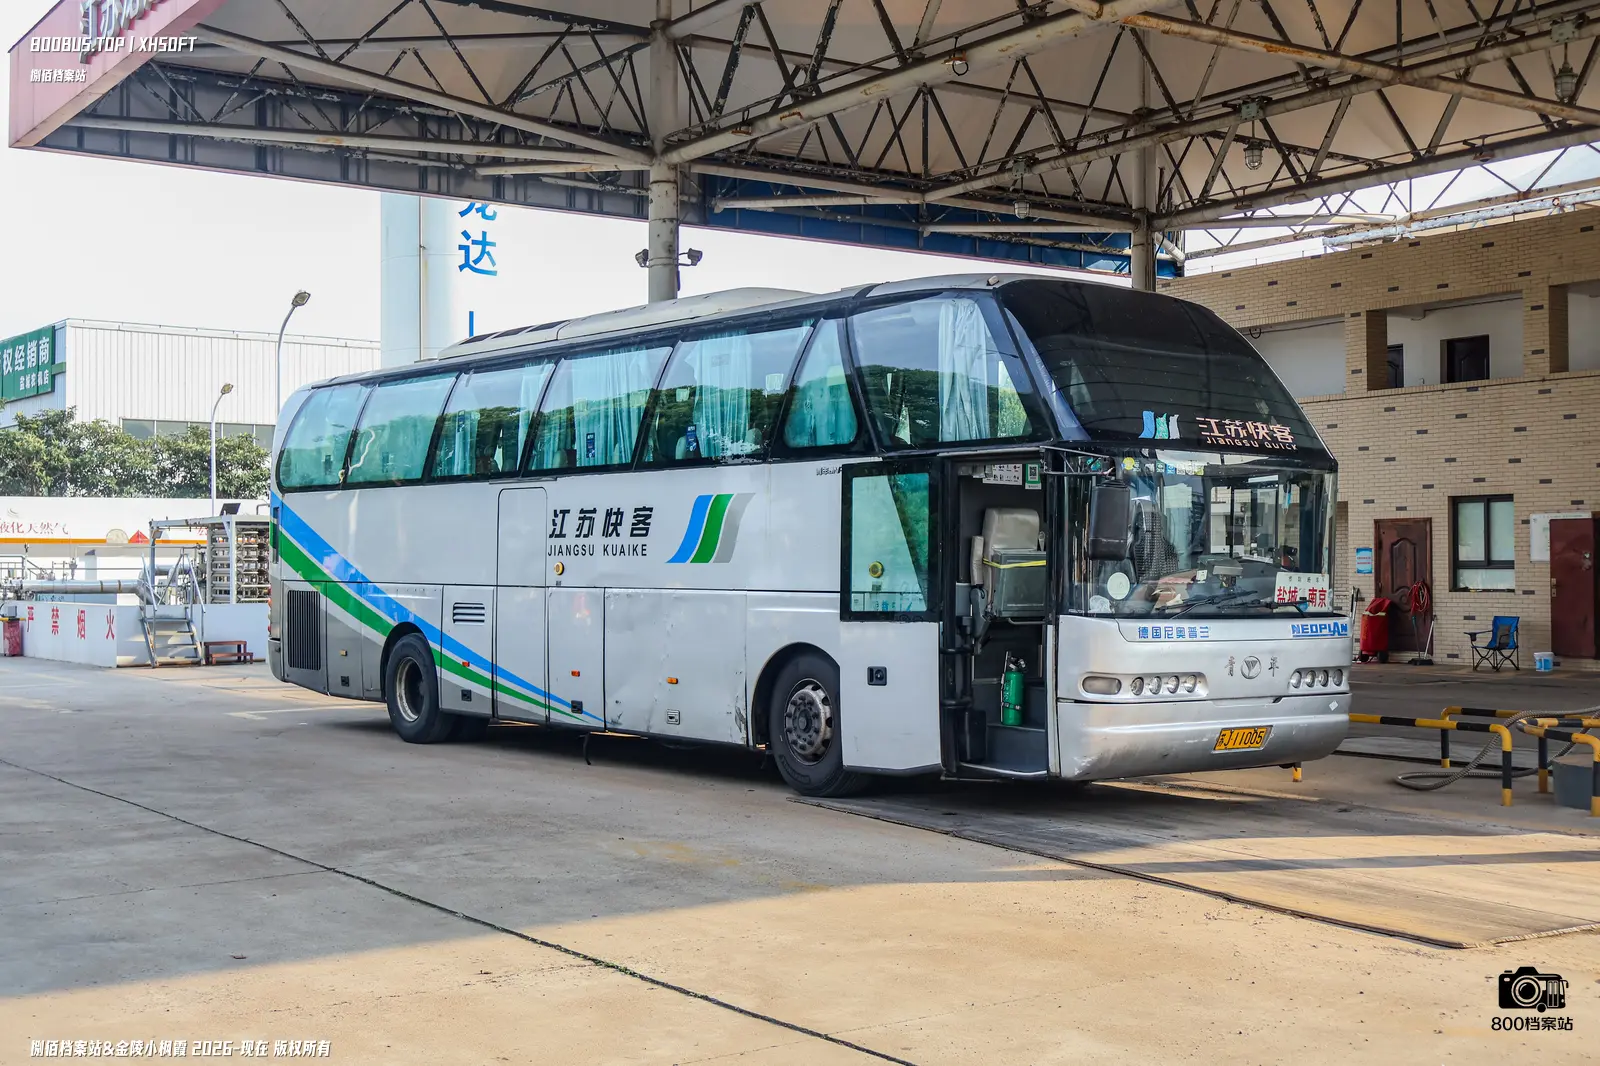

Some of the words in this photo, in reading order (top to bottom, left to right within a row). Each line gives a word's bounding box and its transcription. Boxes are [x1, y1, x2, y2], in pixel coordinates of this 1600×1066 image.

[0, 336, 50, 376] 权经销商
[1196, 416, 1295, 444] 江苏快客
[549, 506, 654, 539] 江苏快客
[548, 544, 595, 557] JIANGSU
[603, 543, 648, 557] KUAIKE
[27, 606, 115, 640] 严禁烟火
[1291, 621, 1348, 638] NEOPLAN
